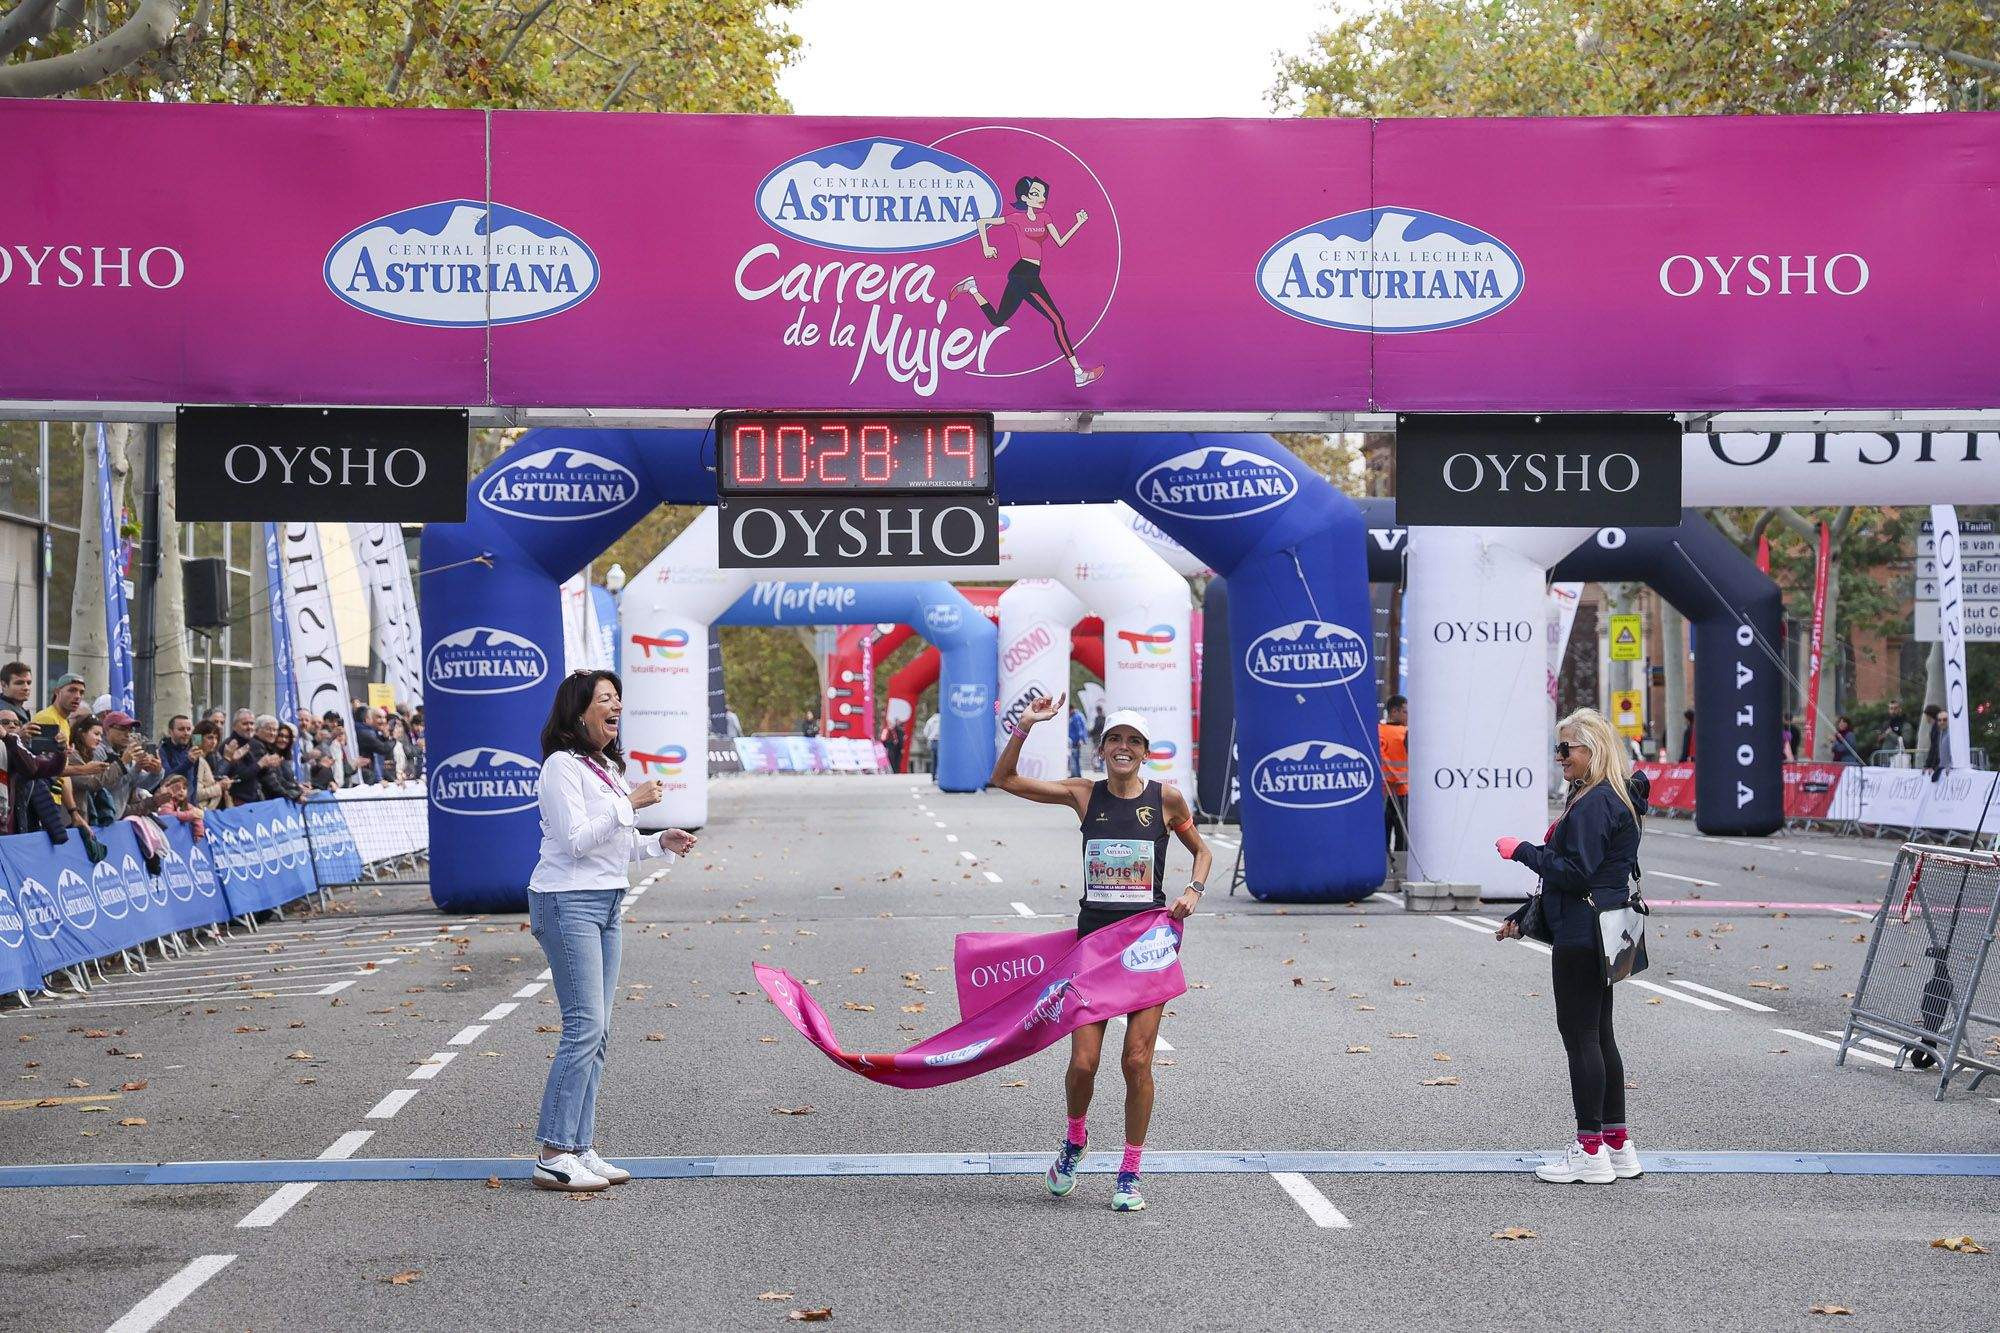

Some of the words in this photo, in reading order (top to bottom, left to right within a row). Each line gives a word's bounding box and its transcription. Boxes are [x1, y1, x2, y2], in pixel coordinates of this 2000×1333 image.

[813, 177, 890, 189] CENTRAL
[898, 177, 975, 189] LECHERA
[775, 179, 981, 223] ASTURIANA
[388, 243, 473, 256] CENTRAL
[1319, 250, 1401, 262] CENTRAL
[1409, 250, 1494, 262] LECHERA
[346, 247, 578, 293] ASTURIANA
[735, 243, 936, 304] Carrera
[1277, 253, 1503, 300] ASTURIANA
[1659, 253, 1869, 297] OYSHO
[783, 305, 820, 347] de
[829, 305, 855, 347] la
[849, 299, 1011, 396] Mujer
[225, 443, 426, 487] OYSHO
[514, 472, 564, 480] CENTRAL
[571, 472, 623, 480] LECHERA
[1169, 471, 1222, 482] CENTRAL
[1227, 468, 1279, 477] LECHERA
[1442, 452, 1639, 493] OYSHO
[488, 477, 626, 502] ASTURIANA
[1151, 478, 1288, 503] ASTURIANA
[733, 505, 986, 558] OYSHO
[752, 581, 856, 620] Marlene
[1434, 620, 1532, 645] OYSHO
[1002, 627, 1050, 673] COSMO
[1254, 648, 1362, 673] ASTURIANA
[432, 655, 539, 680] ASTURIANA
[1736, 625, 1755, 809] VOLVO
[1259, 767, 1367, 793] ASTURIANA
[1434, 766, 1533, 790] OYSHO
[971, 954, 1045, 988] OYSHO
